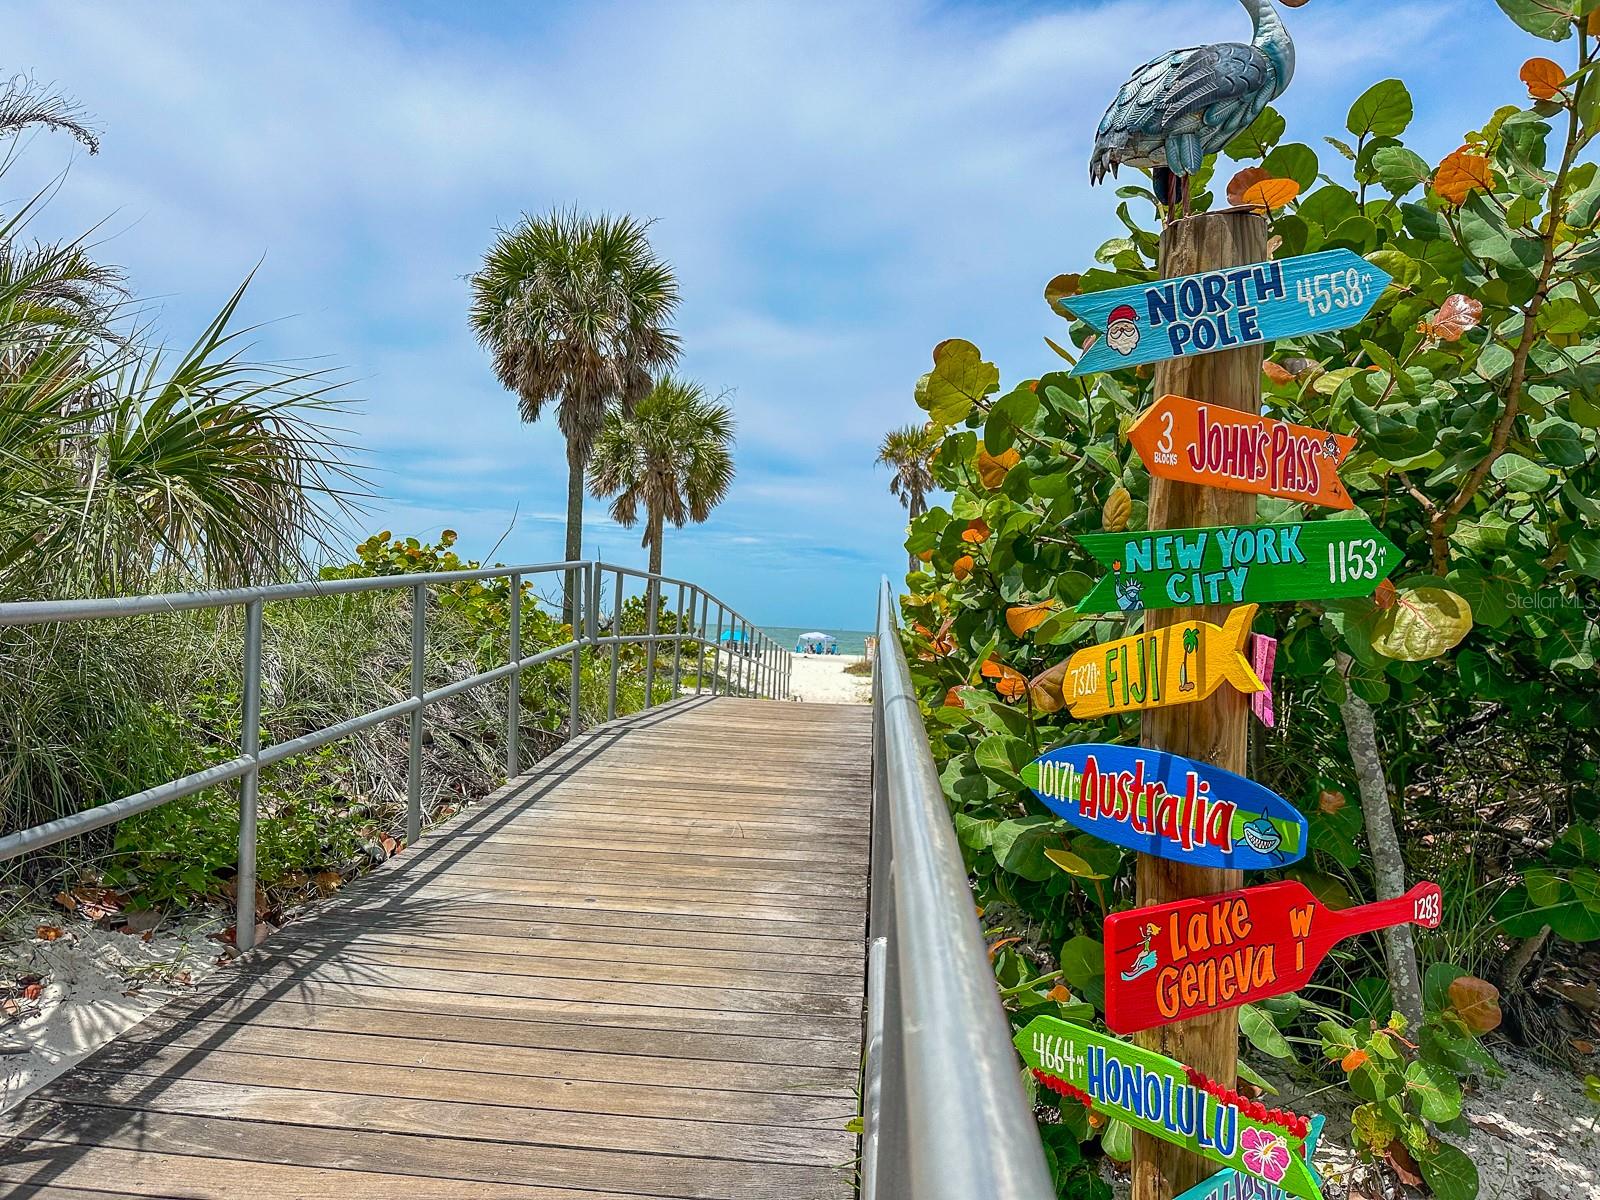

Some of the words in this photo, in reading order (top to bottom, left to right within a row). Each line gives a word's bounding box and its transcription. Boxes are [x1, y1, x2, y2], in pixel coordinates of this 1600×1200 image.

[1145, 260, 1285, 327] NORTH
[1296, 267, 1364, 318] 4558
[1167, 306, 1264, 357] POLE
[1157, 411, 1174, 454] 3
[1186, 406, 1271, 483] JOHN'S
[1269, 422, 1322, 497] PASS
[1153, 451, 1178, 465] BLOCKS
[1124, 532, 1208, 574] NEW
[1214, 524, 1306, 569] YORK
[1328, 538, 1378, 584] 1153
[1165, 565, 1249, 605] CITY
[1071, 662, 1097, 699] 7320
[1105, 636, 1160, 708] FIJI
[1038, 760, 1075, 804] 10171
[1079, 755, 1238, 854] Australia
[1169, 898, 1253, 962] Lake
[1414, 892, 1439, 920] 1283
[1156, 943, 1278, 1019] Geneva
[1032, 1031, 1075, 1080] 4664
[1087, 1044, 1238, 1159] HONOLULU
